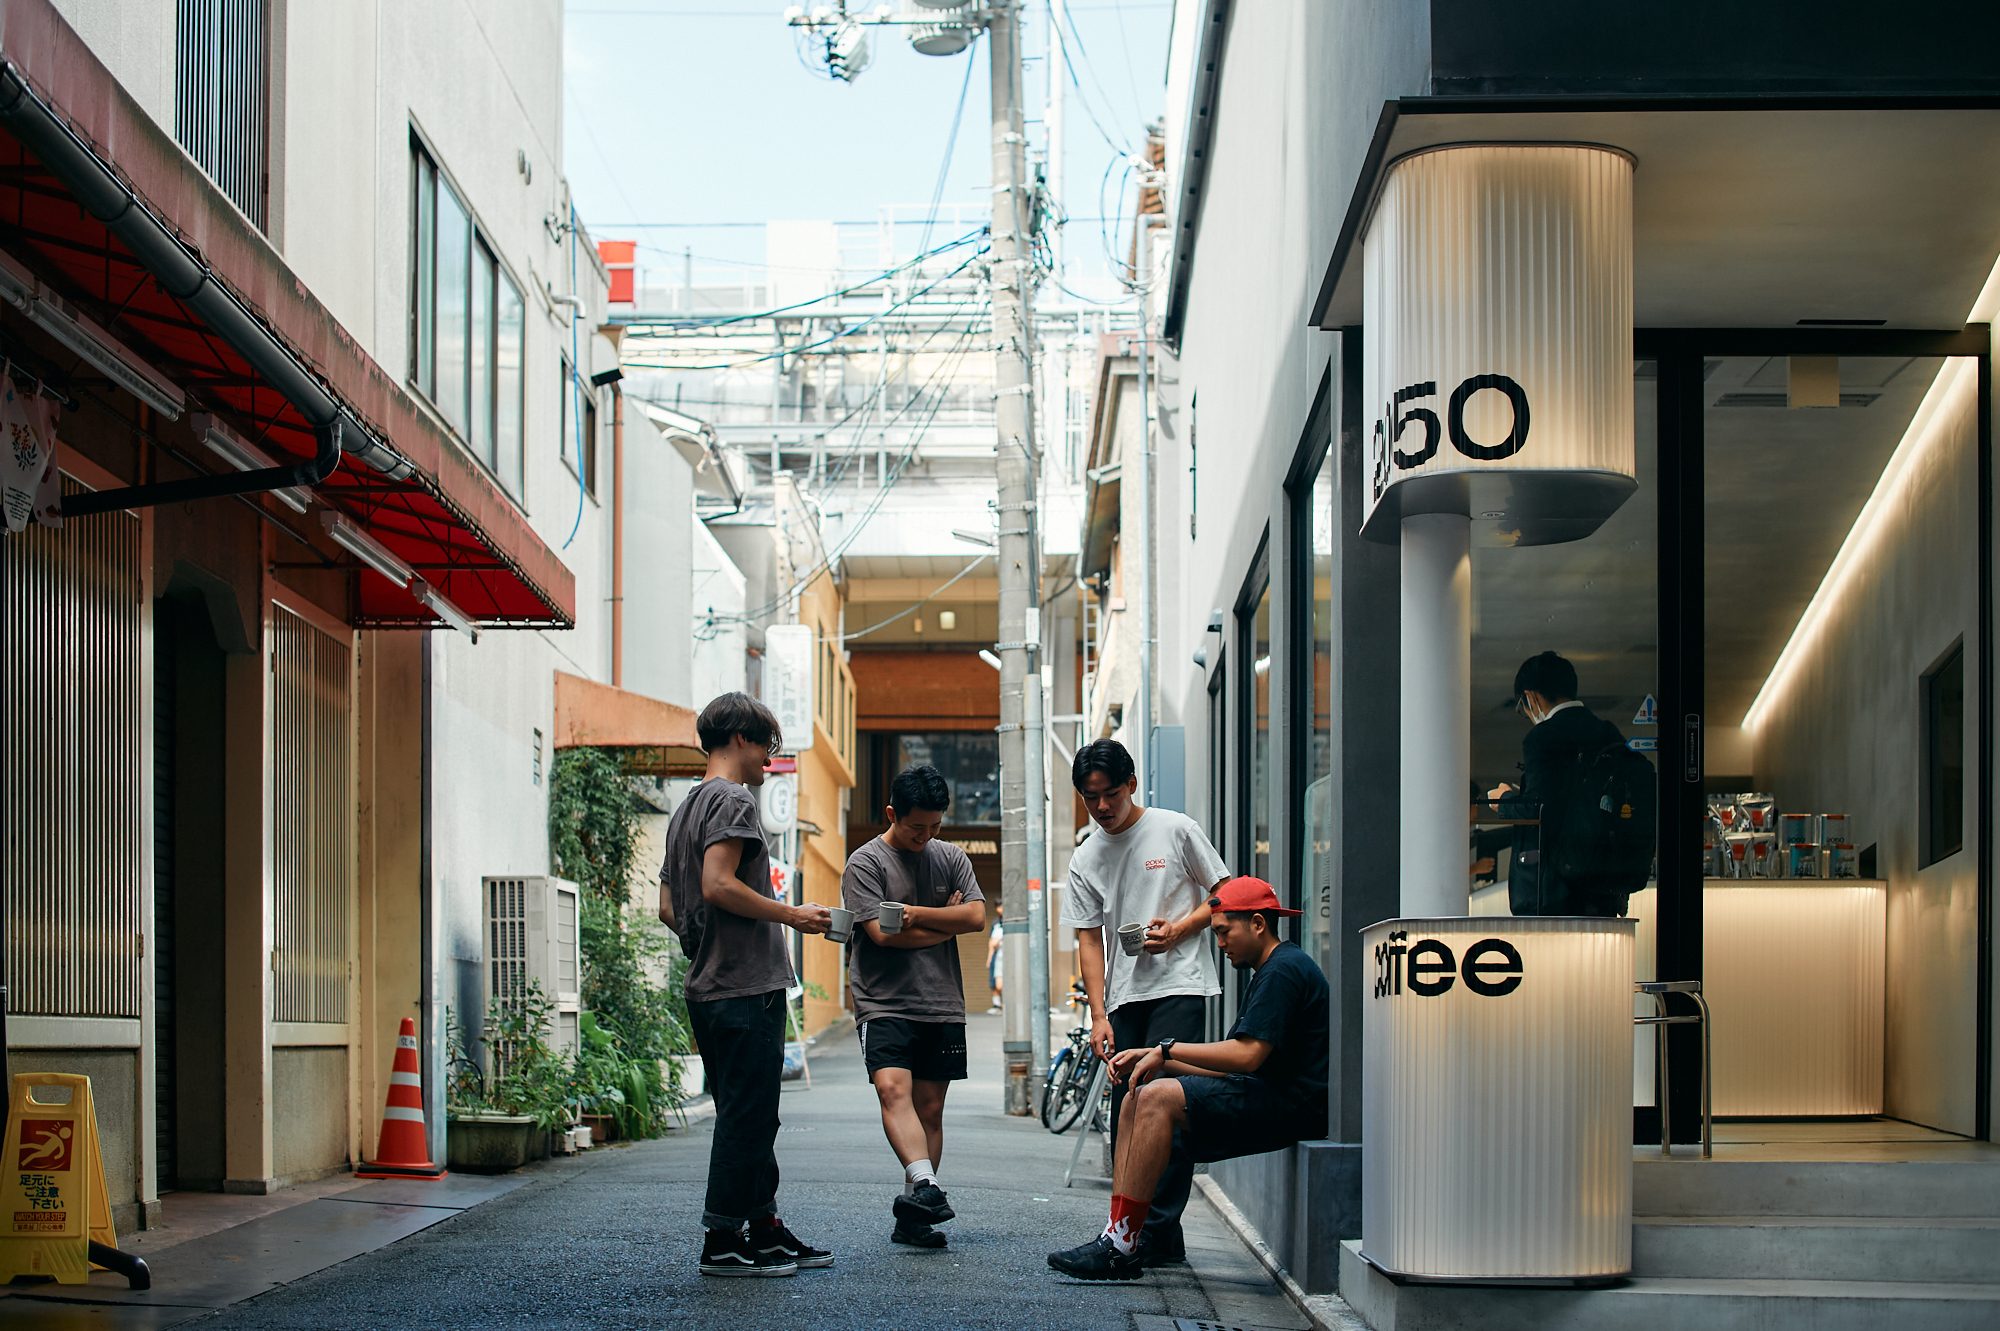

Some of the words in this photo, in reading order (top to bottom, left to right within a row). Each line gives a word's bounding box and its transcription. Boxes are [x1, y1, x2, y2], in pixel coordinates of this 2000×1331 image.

[1374, 930, 1524, 1000] coffee
[19, 1174, 55, 1186] 足元に
[24, 1186, 60, 1198] ご注意
[29, 1198, 64, 1210] 下さい
[15, 1212, 35, 1221] WATCH
[35, 1212, 51, 1221] YOUR
[51, 1212, 65, 1221] STEP
